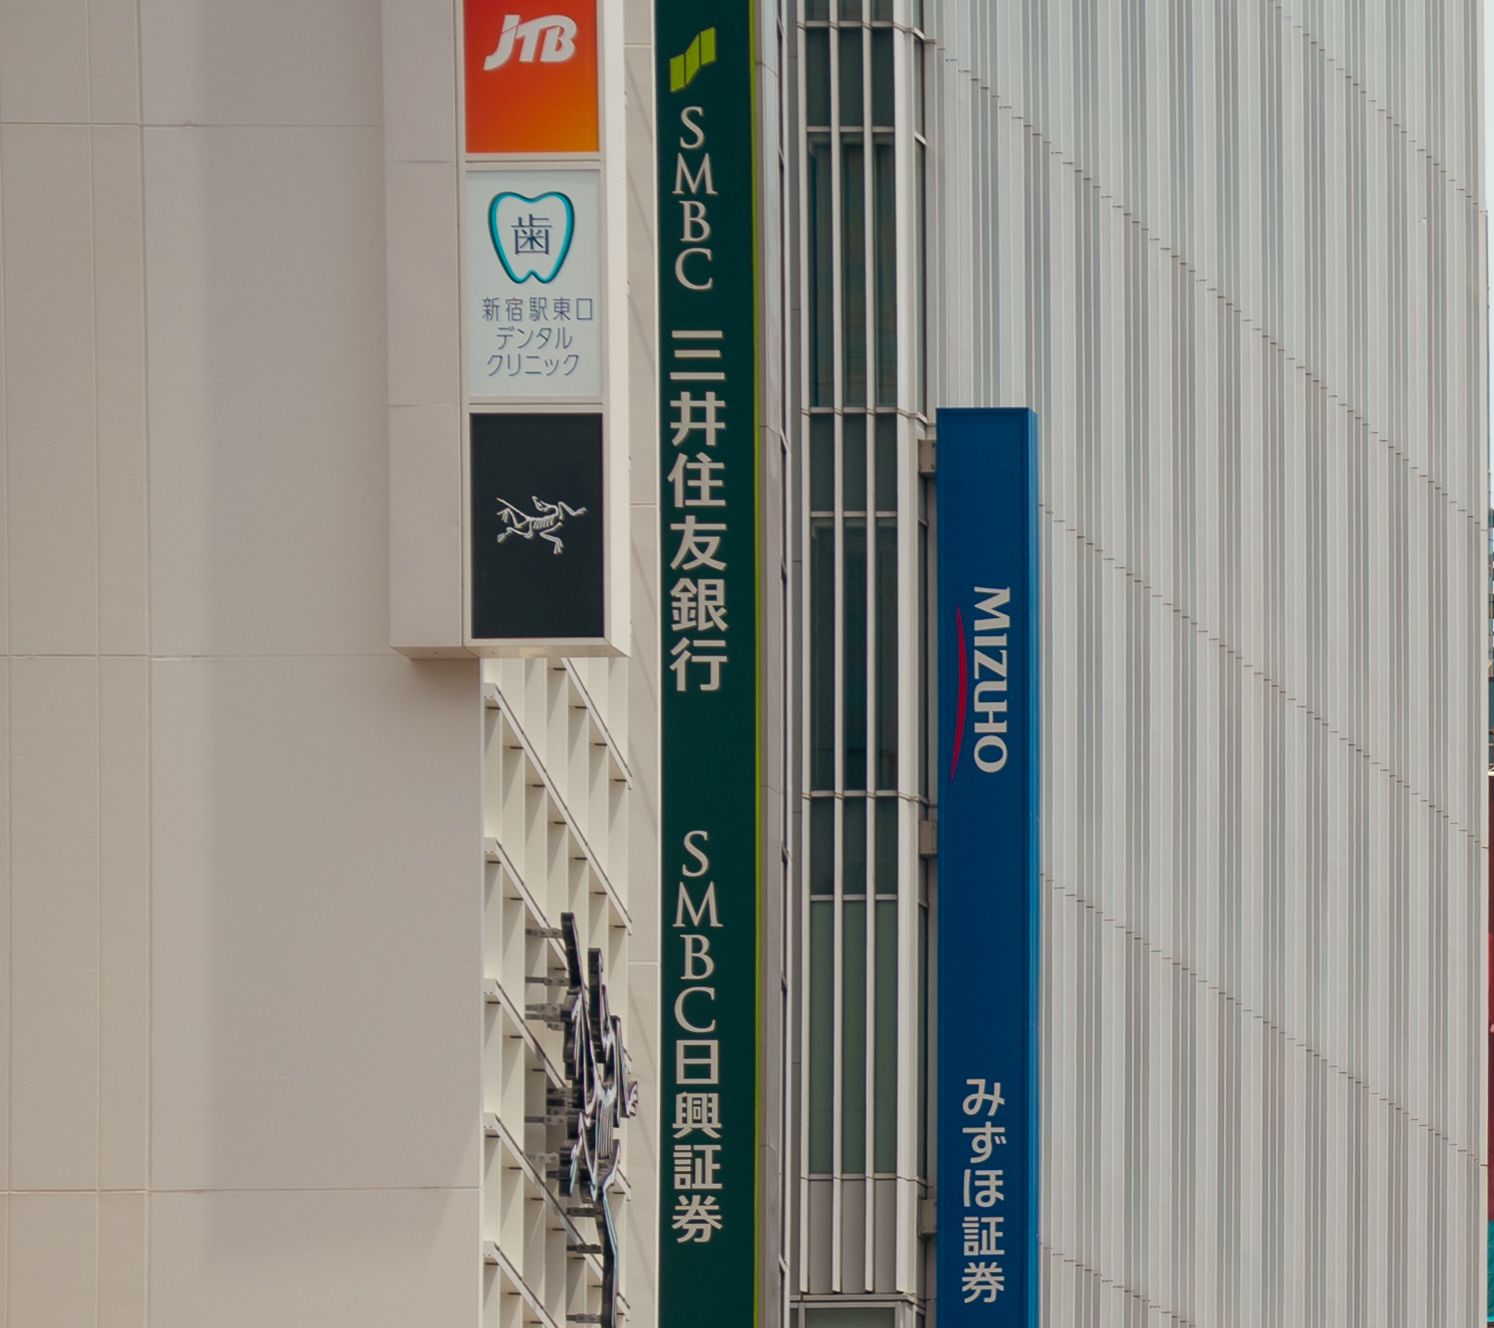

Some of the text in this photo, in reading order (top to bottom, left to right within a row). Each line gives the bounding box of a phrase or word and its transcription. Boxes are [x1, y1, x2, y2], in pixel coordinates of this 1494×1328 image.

[484, 14, 577, 71] JTB
[510, 212, 553, 256] 歯
[481, 296, 595, 324] 新宿駅東口
[486, 354, 580, 378] クリニック
[496, 328, 572, 352] デンタル
[668, 106, 728, 693] SMBC 三井住友銀行
[973, 586, 1011, 773] MIZUHO
[672, 830, 723, 1243] SMBC日興証券
[961, 1078, 1005, 1303] みずほ証券
